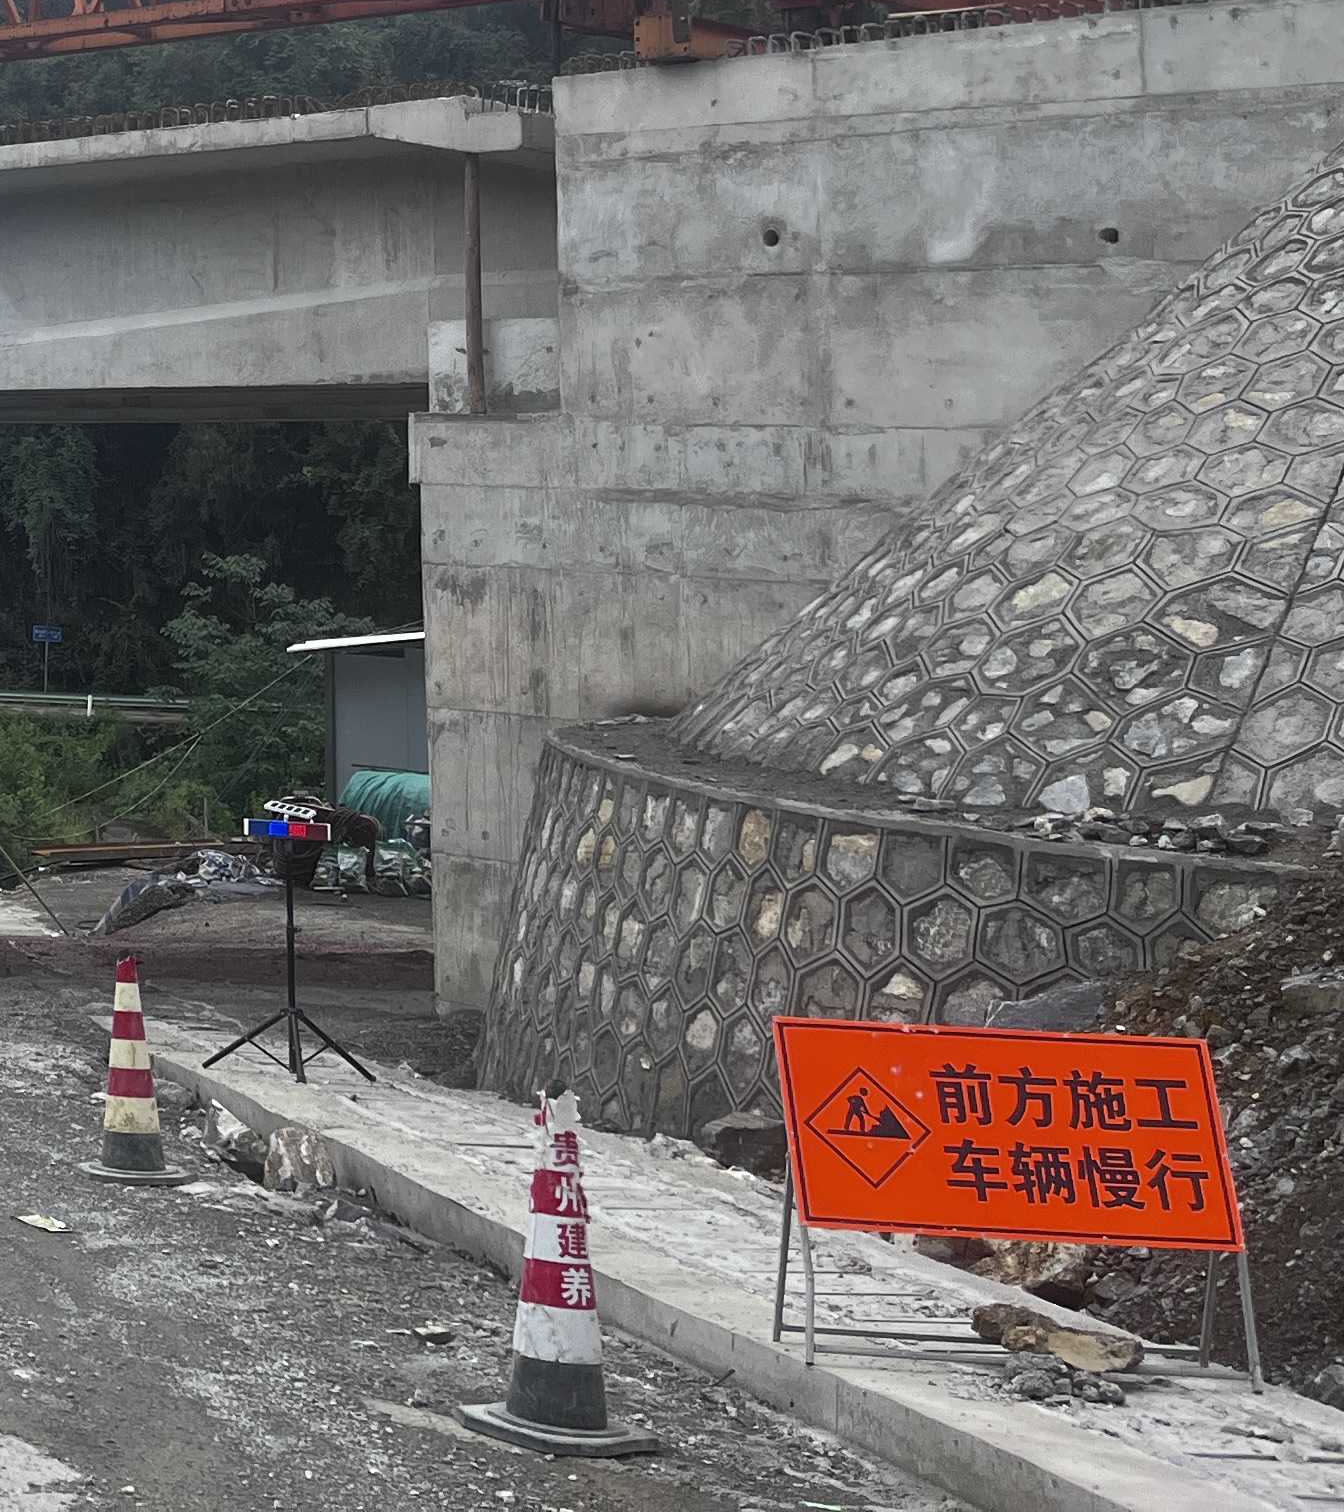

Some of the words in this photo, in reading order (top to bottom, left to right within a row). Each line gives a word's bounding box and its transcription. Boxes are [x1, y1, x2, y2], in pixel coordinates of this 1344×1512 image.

[929, 1063, 1199, 1132] 前方施工
[944, 1139, 1210, 1212] 车辆慢行
[552, 1130, 592, 1306] 贵州建养
